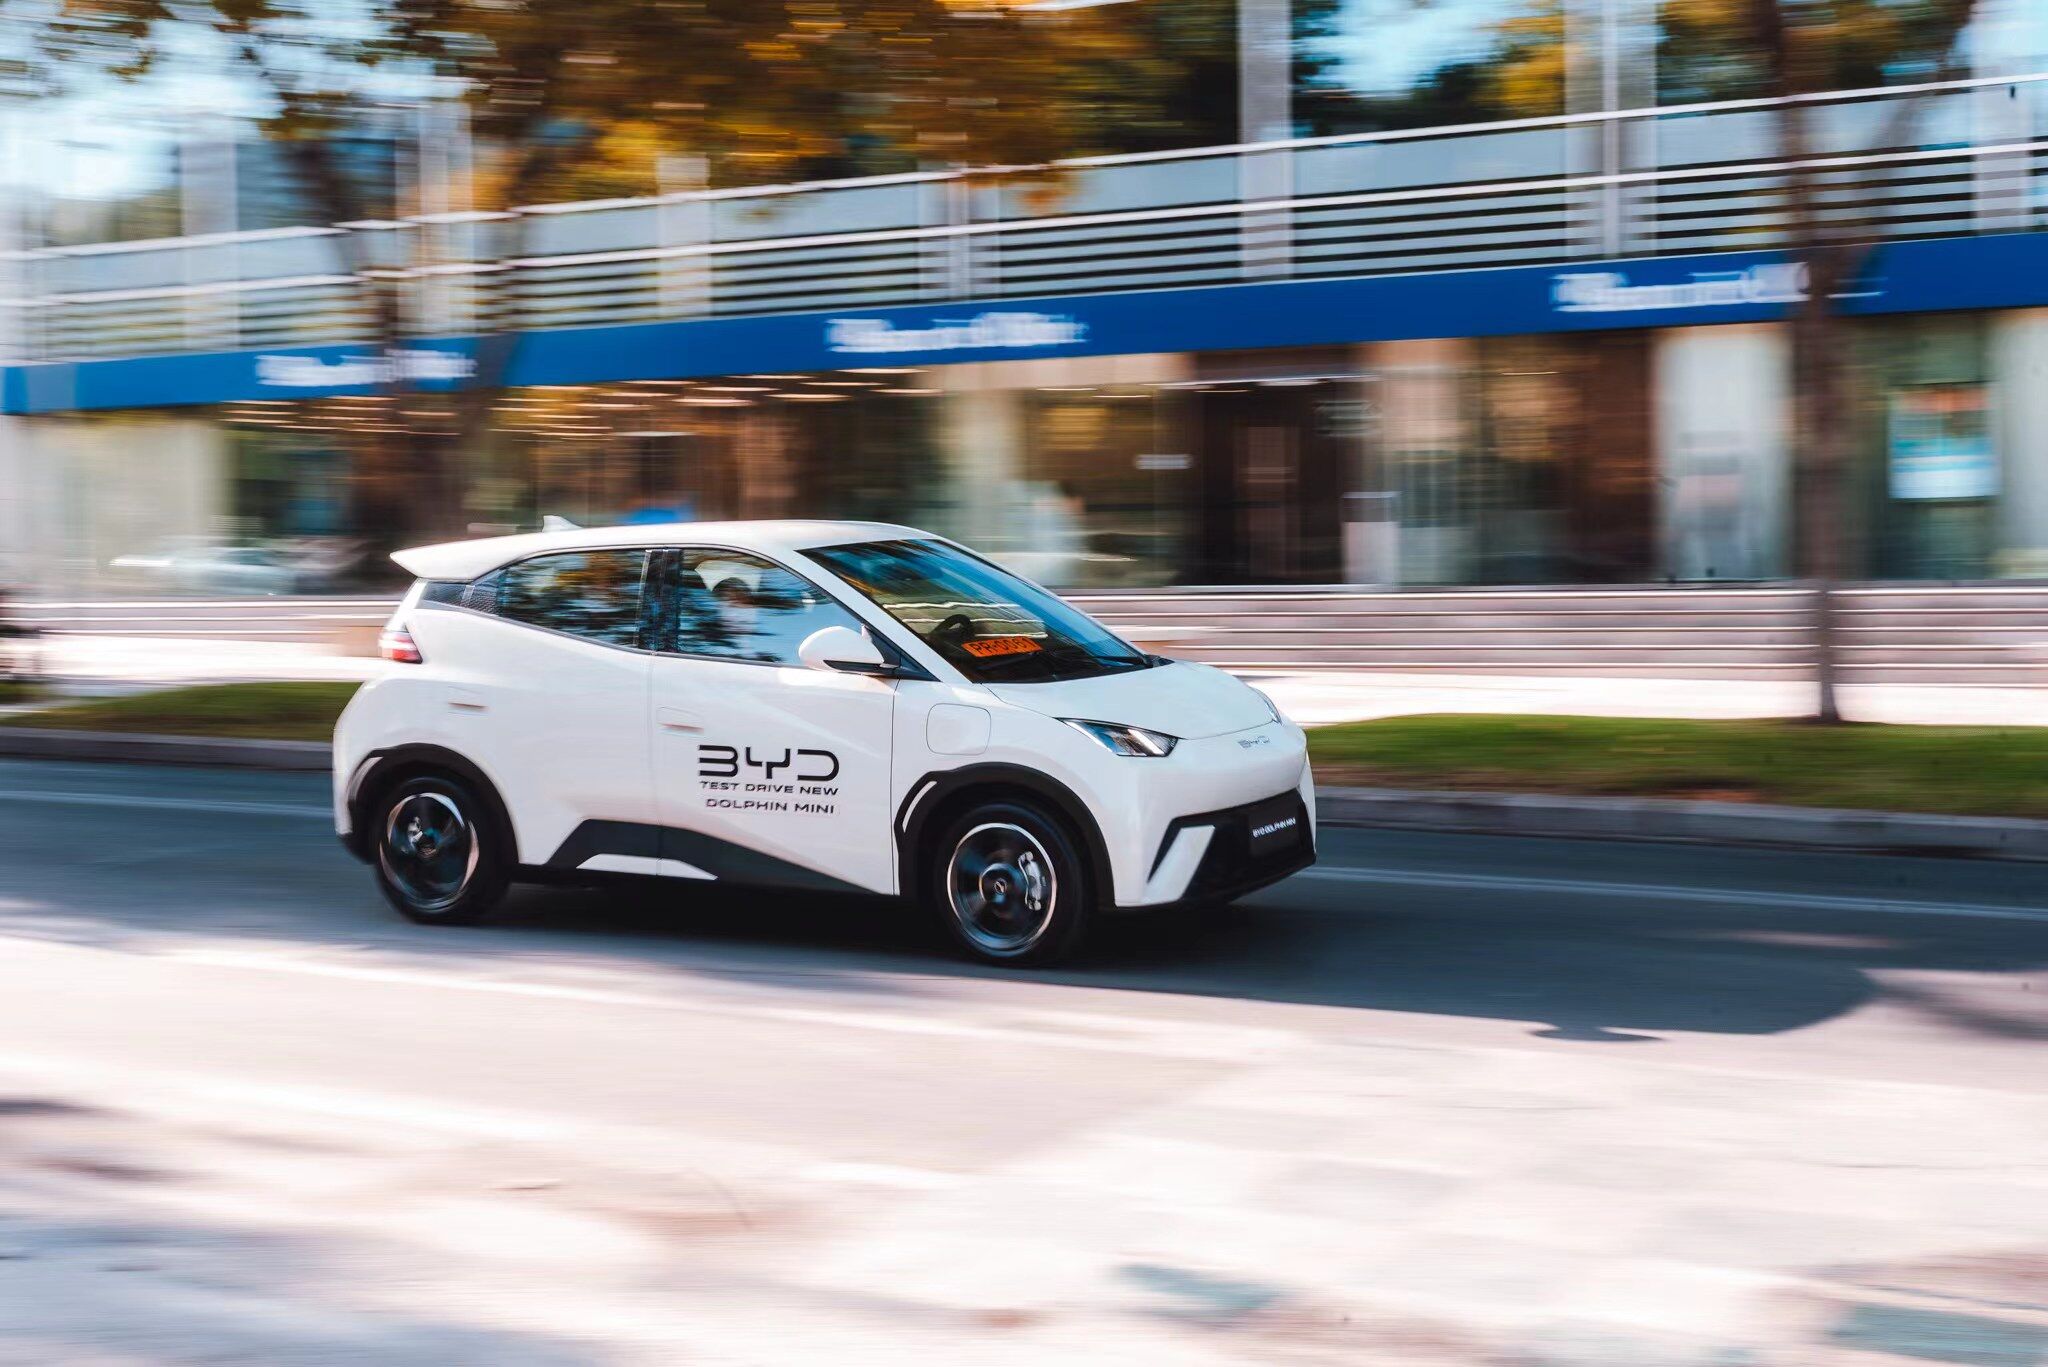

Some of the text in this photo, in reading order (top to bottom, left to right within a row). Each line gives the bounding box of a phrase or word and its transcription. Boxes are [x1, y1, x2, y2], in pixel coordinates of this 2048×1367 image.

[698, 745, 840, 782] BYD
[700, 781, 839, 796] TEST DRIVE NEW
[706, 798, 835, 814] DOLPHIN MINI
